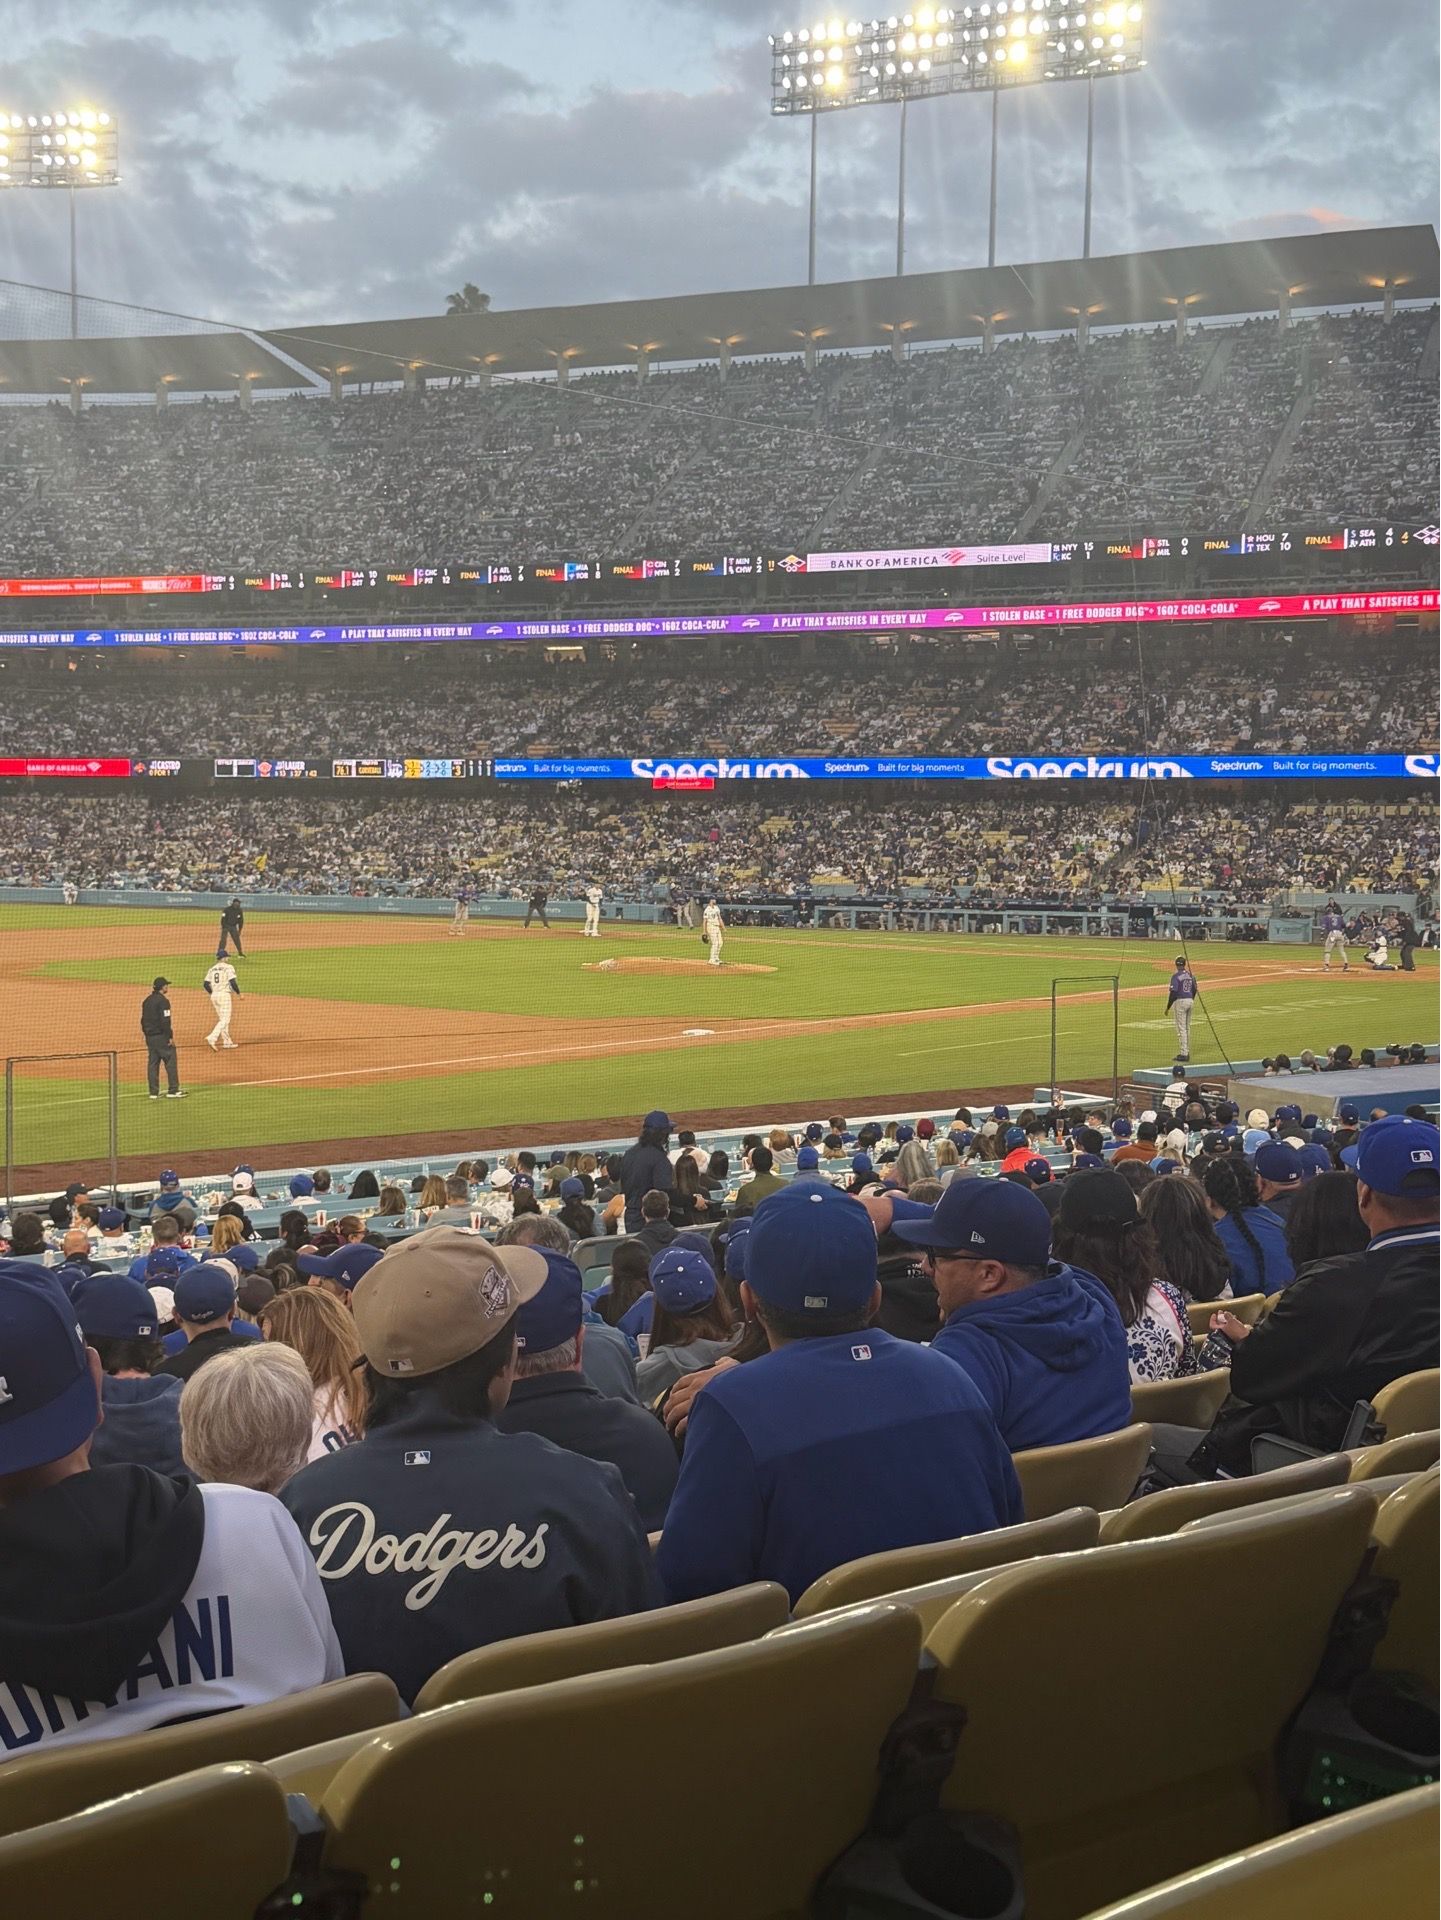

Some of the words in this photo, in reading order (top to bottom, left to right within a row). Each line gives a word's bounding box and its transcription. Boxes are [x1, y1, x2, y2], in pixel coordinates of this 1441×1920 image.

[1359, 529, 1375, 538] SEA
[1385, 528, 1393, 536] 4
[1401, 531, 1409, 540] 4
[1156, 539, 1170, 547] STL
[1181, 537, 1189, 546] 0
[1256, 534, 1275, 543] HOU
[1281, 533, 1289, 541] 7
[1305, 536, 1333, 545] FINAL
[1358, 539, 1376, 547] ATH
[1385, 537, 1393, 546] 0
[1061, 543, 1078, 552] NYY
[1084, 542, 1094, 551] 15
[1204, 540, 1230, 549] FINAL
[1256, 543, 1270, 551] TEX
[1280, 542, 1291, 550] 10
[1106, 546, 1132, 554] FINAL
[1156, 548, 1171, 556] MIL
[1181, 547, 1188, 555] 6
[756, 556, 763, 564] 5
[977, 554, 1001, 563] Suite
[1002, 553, 1026, 562] Level
[1061, 553, 1072, 561] KC
[674, 560, 681, 568] 7
[830, 559, 863, 568] BANK
[864, 558, 880, 567] OF
[884, 556, 938, 567] AMERICA
[518, 565, 524, 574] 7
[613, 566, 634, 574] FINAL
[693, 563, 715, 571] FINAL
[756, 565, 762, 573] 2
[460, 571, 480, 579] FINAL
[499, 574, 512, 582] BOS
[518, 573, 524, 582] 6
[536, 569, 556, 577] FINAL
[595, 571, 601, 579] 8
[654, 569, 670, 577] NYM
[674, 569, 681, 577] 2
[229, 575, 235, 583] 6
[245, 578, 263, 586] FINAL
[315, 576, 334, 584] FINAL
[442, 576, 451, 584] 12
[1302, 600, 1311, 610] A
[1313, 599, 1338, 610] PLAY
[1341, 597, 1366, 608] THAT
[1369, 595, 1419, 608] SATISFIES
[1422, 594, 1434, 605] IN
[982, 611, 987, 621] 1
[989, 610, 1021, 621] STOLEN
[1023, 610, 1046, 620] BASE
[1055, 609, 1060, 619] 1
[1062, 608, 1083, 619] FREE
[1086, 607, 1122, 618] DODGER
[773, 618, 780, 628] A
[781, 617, 802, 627] PLAY
[803, 616, 824, 627] THAT
[826, 615, 867, 626] SATISFIES
[869, 615, 879, 625] IN
[881, 614, 906, 625] EVERY
[909, 613, 927, 624] WAY
[341, 629, 347, 639] A
[348, 629, 366, 639] PLAY
[367, 628, 385, 638] THAT
[386, 627, 422, 638] SATISFIES
[423, 627, 431, 636] IN
[433, 627, 455, 636] EVERY
[456, 626, 472, 636] WAY
[517, 625, 521, 634] 1
[522, 624, 549, 634] STOLEN
[551, 624, 570, 634] BASE
[578, 624, 582, 632] 1
[584, 623, 602, 632] FREE
[603, 622, 634, 632] DODGER
[29, 634, 37, 643] IN
[38, 634, 59, 643] EVERY
[60, 633, 75, 642] WAY
[114, 633, 119, 642] 1
[120, 633, 144, 642] STOLEN
[145, 632, 161, 642] BASE
[173, 632, 189, 641] FREE
[190, 632, 217, 641] DODGER
[495, 764, 524, 773] ectrum
[534, 764, 550, 772] Built
[551, 764, 562, 772] for
[563, 764, 575, 774] big
[825, 762, 866, 774] Spectrum
[878, 763, 896, 772] Built
[898, 763, 910, 772] for
[911, 763, 924, 773] big
[1211, 761, 1260, 772] Spectrum
[1273, 761, 1293, 770] Built
[1296, 761, 1310, 770] for
[1312, 761, 1327, 772] big
[1329, 761, 1377, 770] moments.
[214, 973, 220, 984] 8
[309, 1501, 550, 1611] Dodgers
